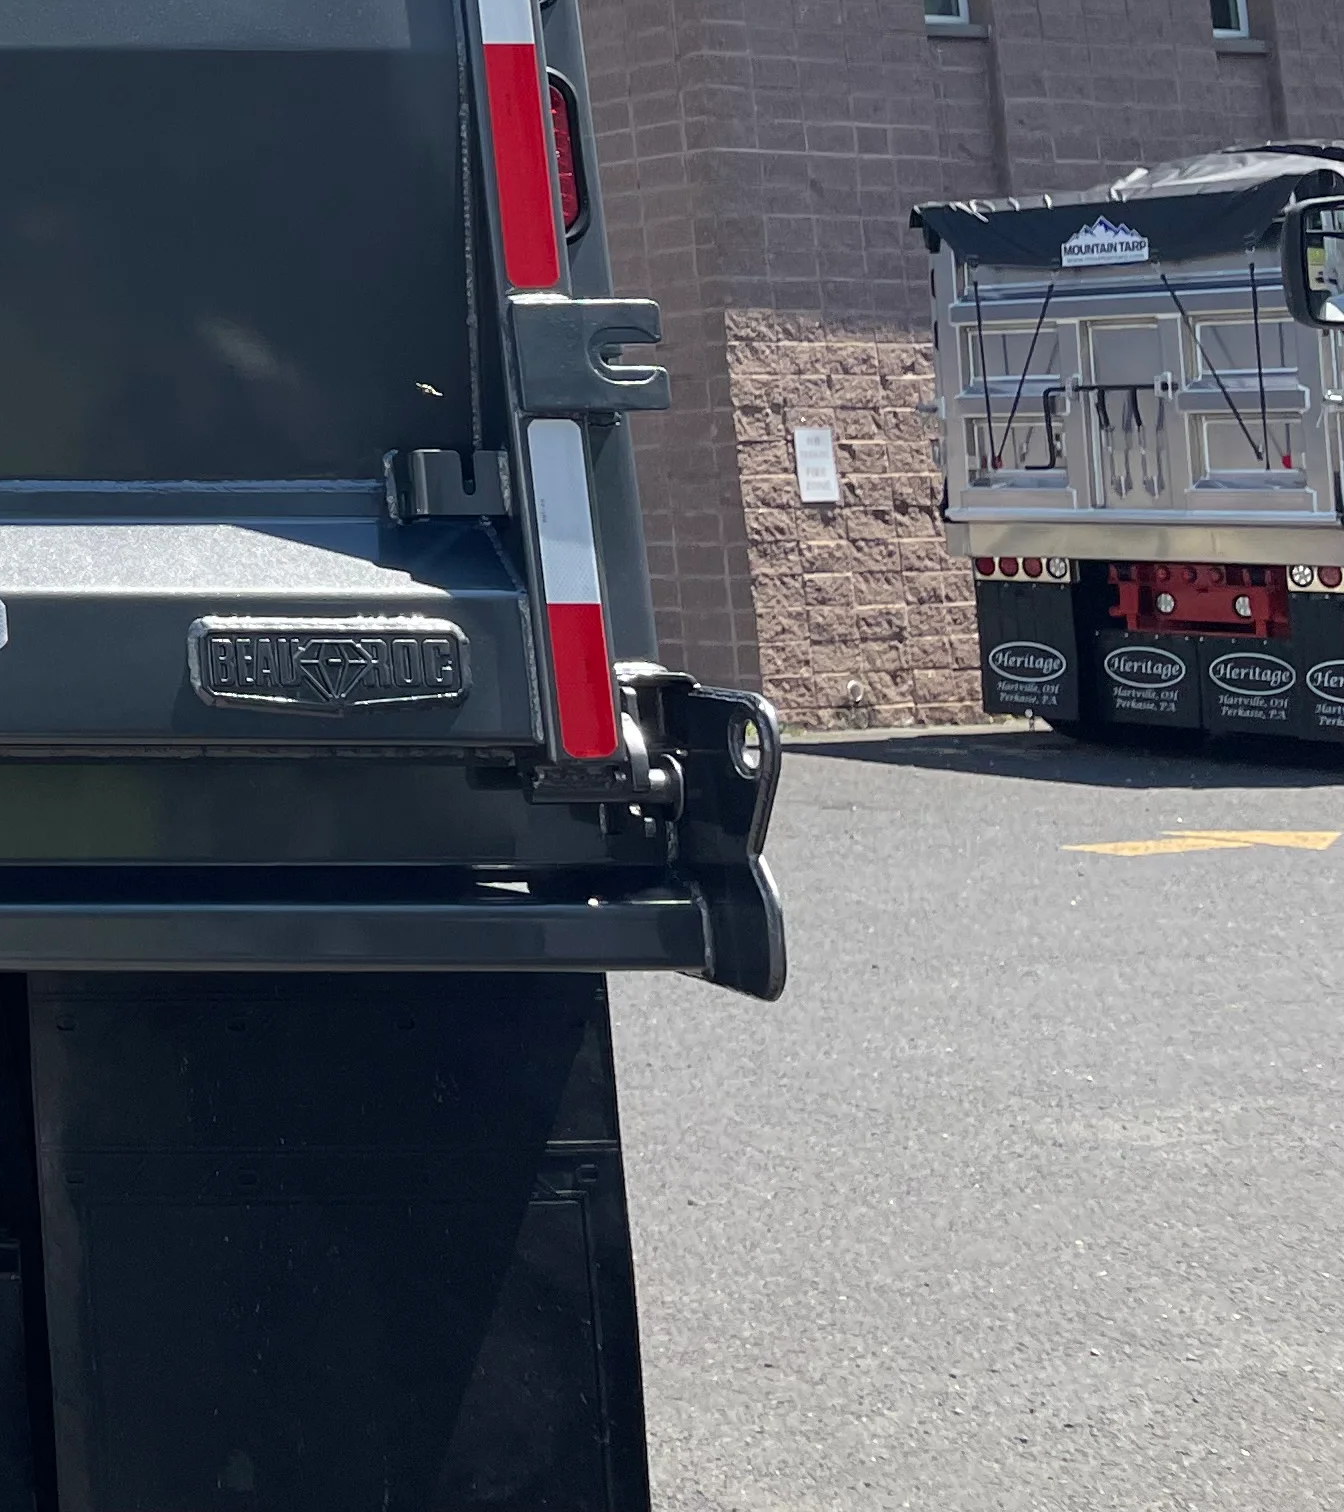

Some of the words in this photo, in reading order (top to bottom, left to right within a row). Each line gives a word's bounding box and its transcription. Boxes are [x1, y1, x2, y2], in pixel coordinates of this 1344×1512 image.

[1063, 242, 1118, 256] MOUNTAIN
[1118, 240, 1147, 253] TARP
[994, 650, 1061, 675] Heritage
[1109, 656, 1180, 680] Heritage
[1214, 662, 1291, 687] Heritage
